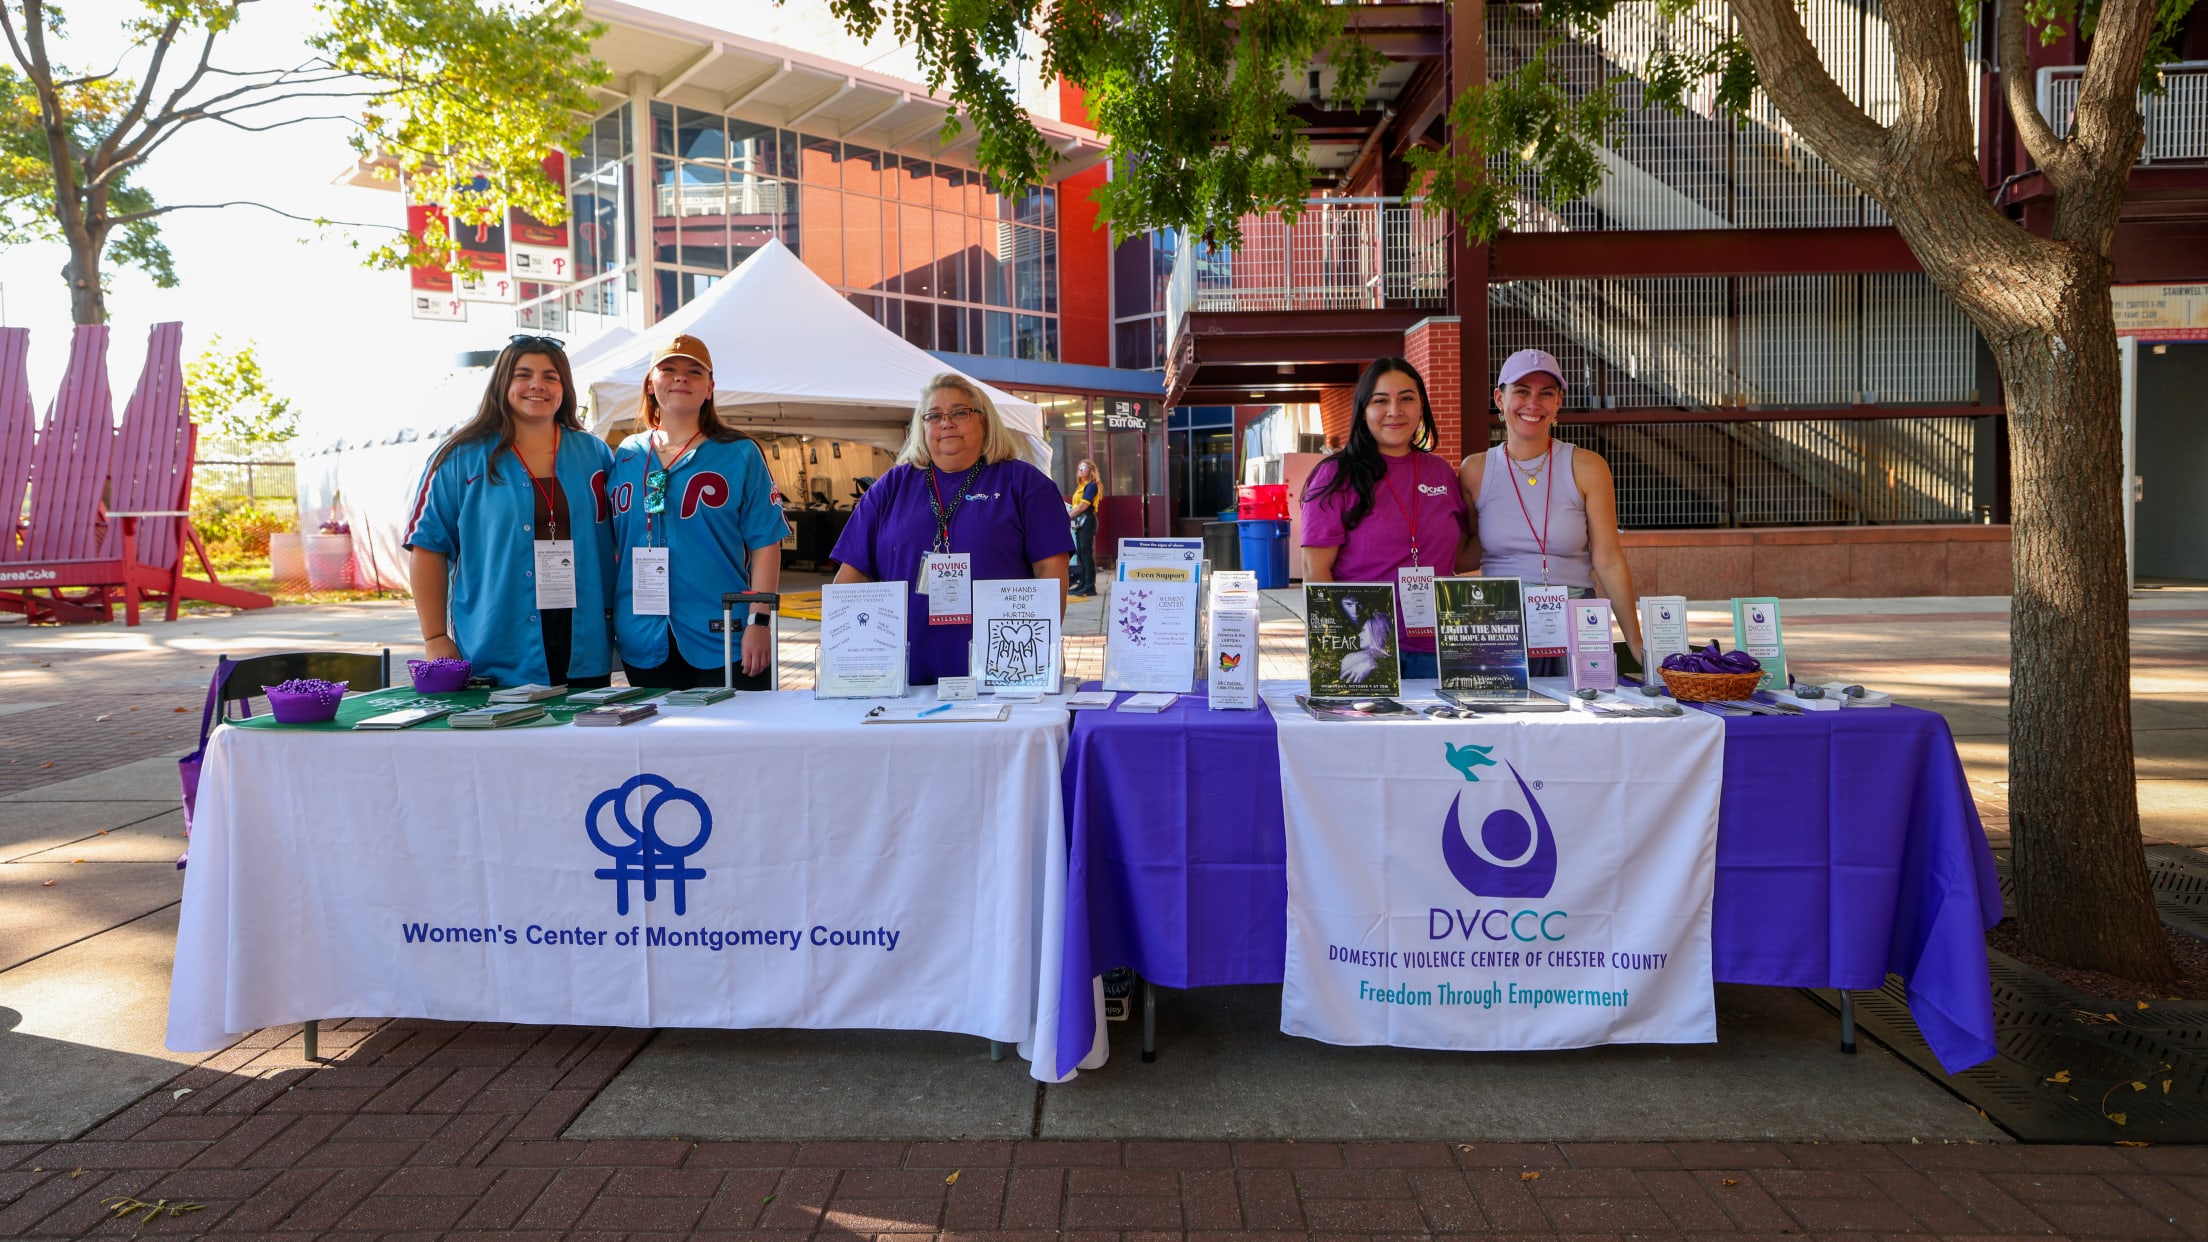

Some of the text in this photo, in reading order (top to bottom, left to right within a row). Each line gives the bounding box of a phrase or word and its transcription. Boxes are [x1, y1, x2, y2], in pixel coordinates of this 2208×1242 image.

[1109, 417, 1146, 429] EXIT ONLY
[611, 481, 633, 518] 10
[680, 471, 729, 519] P
[931, 562, 968, 571] ROVING
[0, 569, 56, 580] areaCoke
[1155, 572, 1185, 580] Support
[1401, 575, 1433, 584] ROVING
[1527, 594, 1565, 603] ROVING
[1440, 624, 1469, 634] LIGHT
[1470, 624, 1490, 634] THE
[1491, 624, 1520, 634] NIGHT
[1321, 635, 1358, 650] FEAR
[1444, 634, 1459, 642] FOR
[1460, 634, 1480, 642] HOPE
[1429, 907, 1567, 942] DVCCC
[402, 922, 900, 951] Women's Center of Montgomery County
[1329, 945, 1667, 970] DOMESTIC VIOLENCE CENTER OF CHESTER COUNTY
[1359, 980, 1629, 1009] Freedom Through Empowerment
